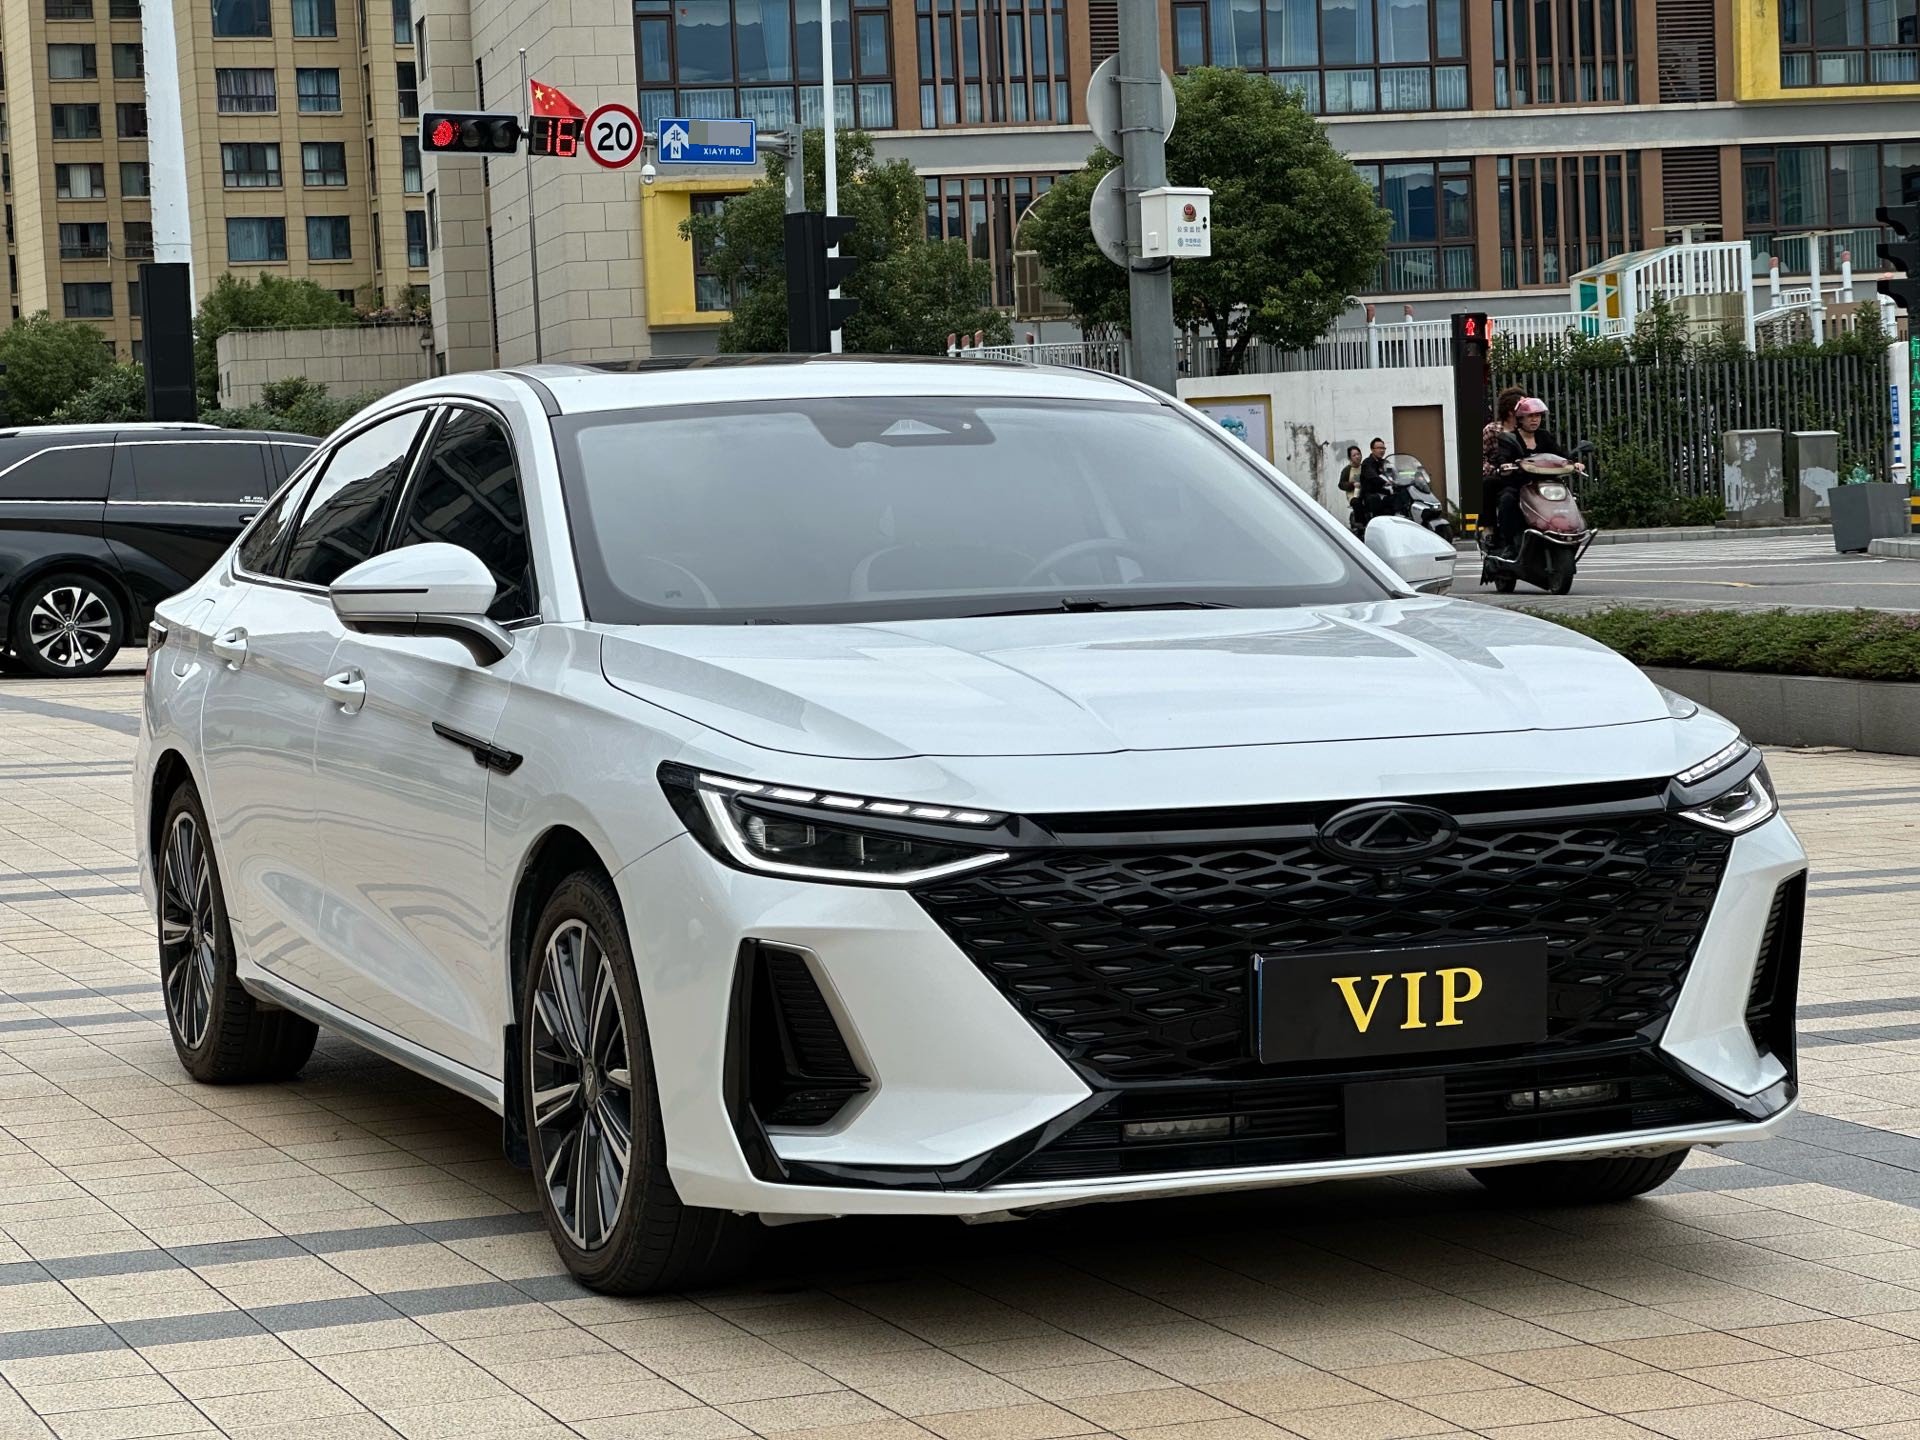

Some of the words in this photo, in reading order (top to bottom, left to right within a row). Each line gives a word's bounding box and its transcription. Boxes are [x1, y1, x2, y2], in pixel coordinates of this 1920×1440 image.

[546, 118, 576, 156] 16
[597, 122, 633, 151] 20
[671, 129, 681, 141] 北
[672, 146, 679, 155] N
[729, 148, 743, 156] RD.
[1331, 967, 1483, 1033] VIP
